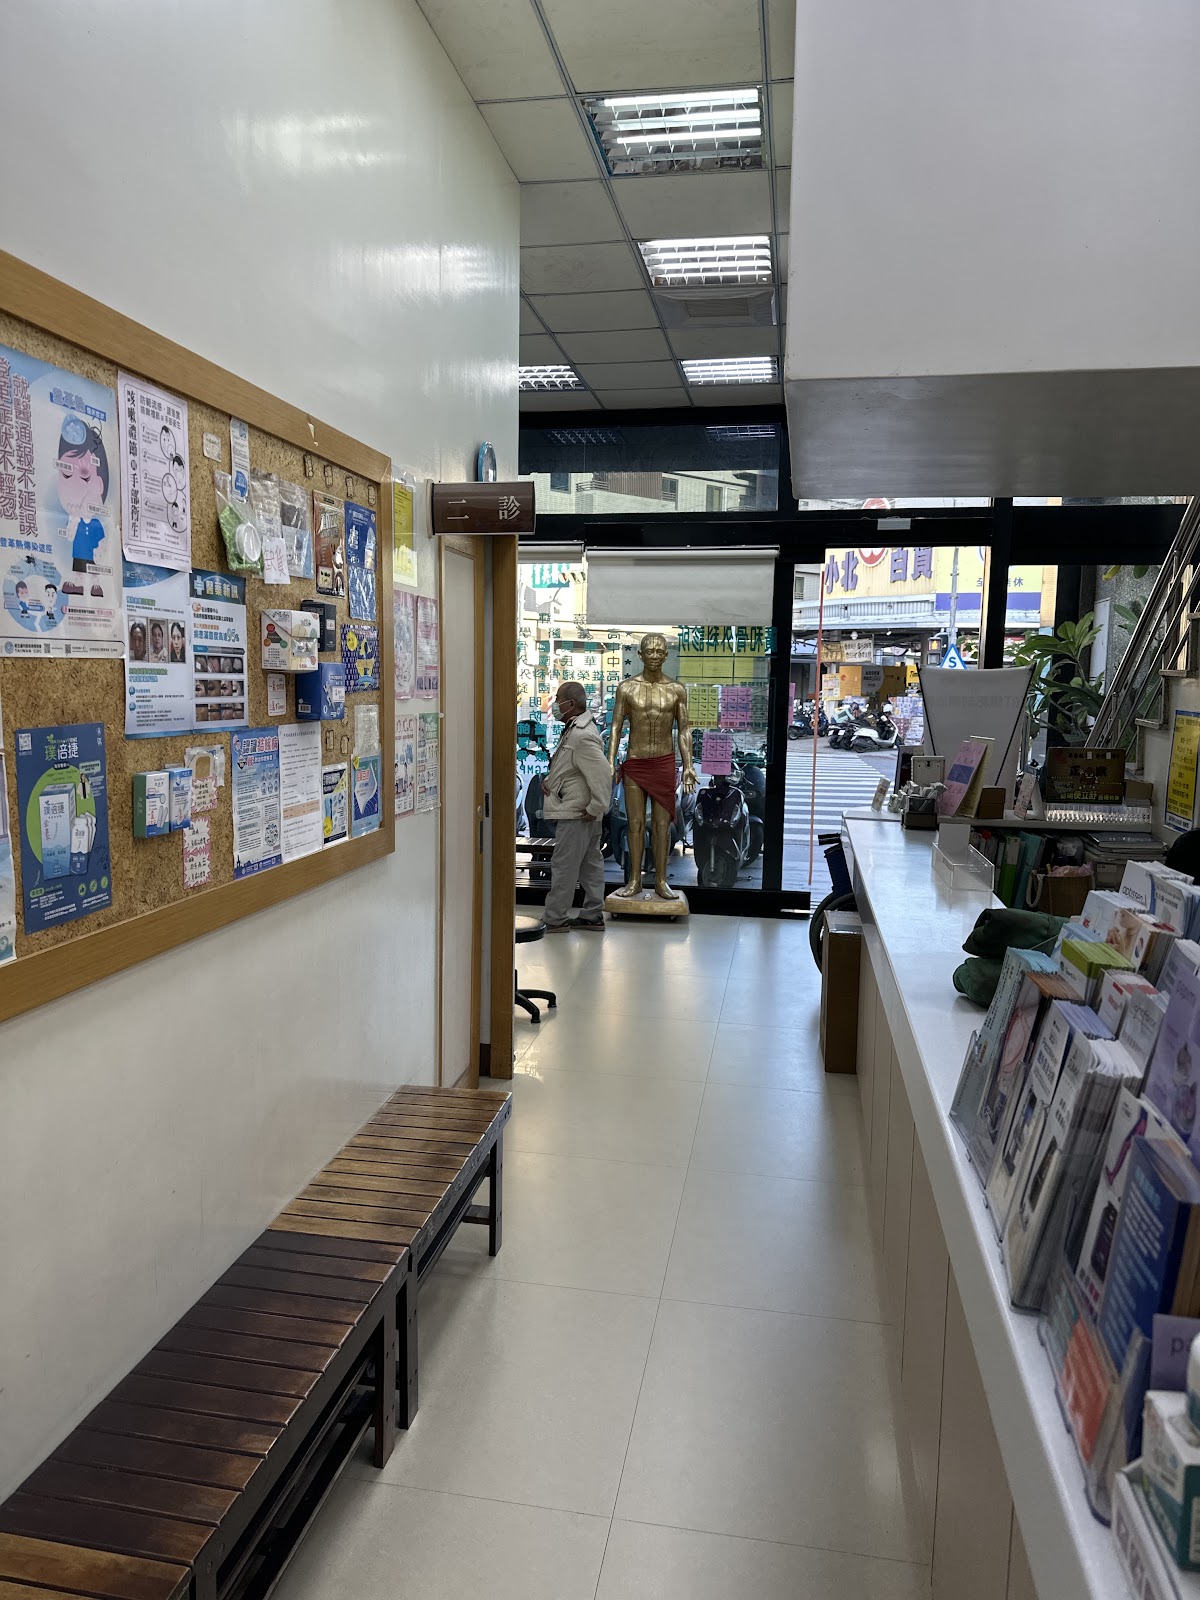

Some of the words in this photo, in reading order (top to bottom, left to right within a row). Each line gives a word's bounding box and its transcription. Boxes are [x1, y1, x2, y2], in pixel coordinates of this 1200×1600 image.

[12, 374, 38, 537] 就醫通報不延誤
[447, 495, 521, 521] 二診
[824, 550, 859, 594] 小北
[889, 546, 933, 583] 百貨
[948, 656, 957, 668] S
[44, 742, 80, 761] 璞倍捷
